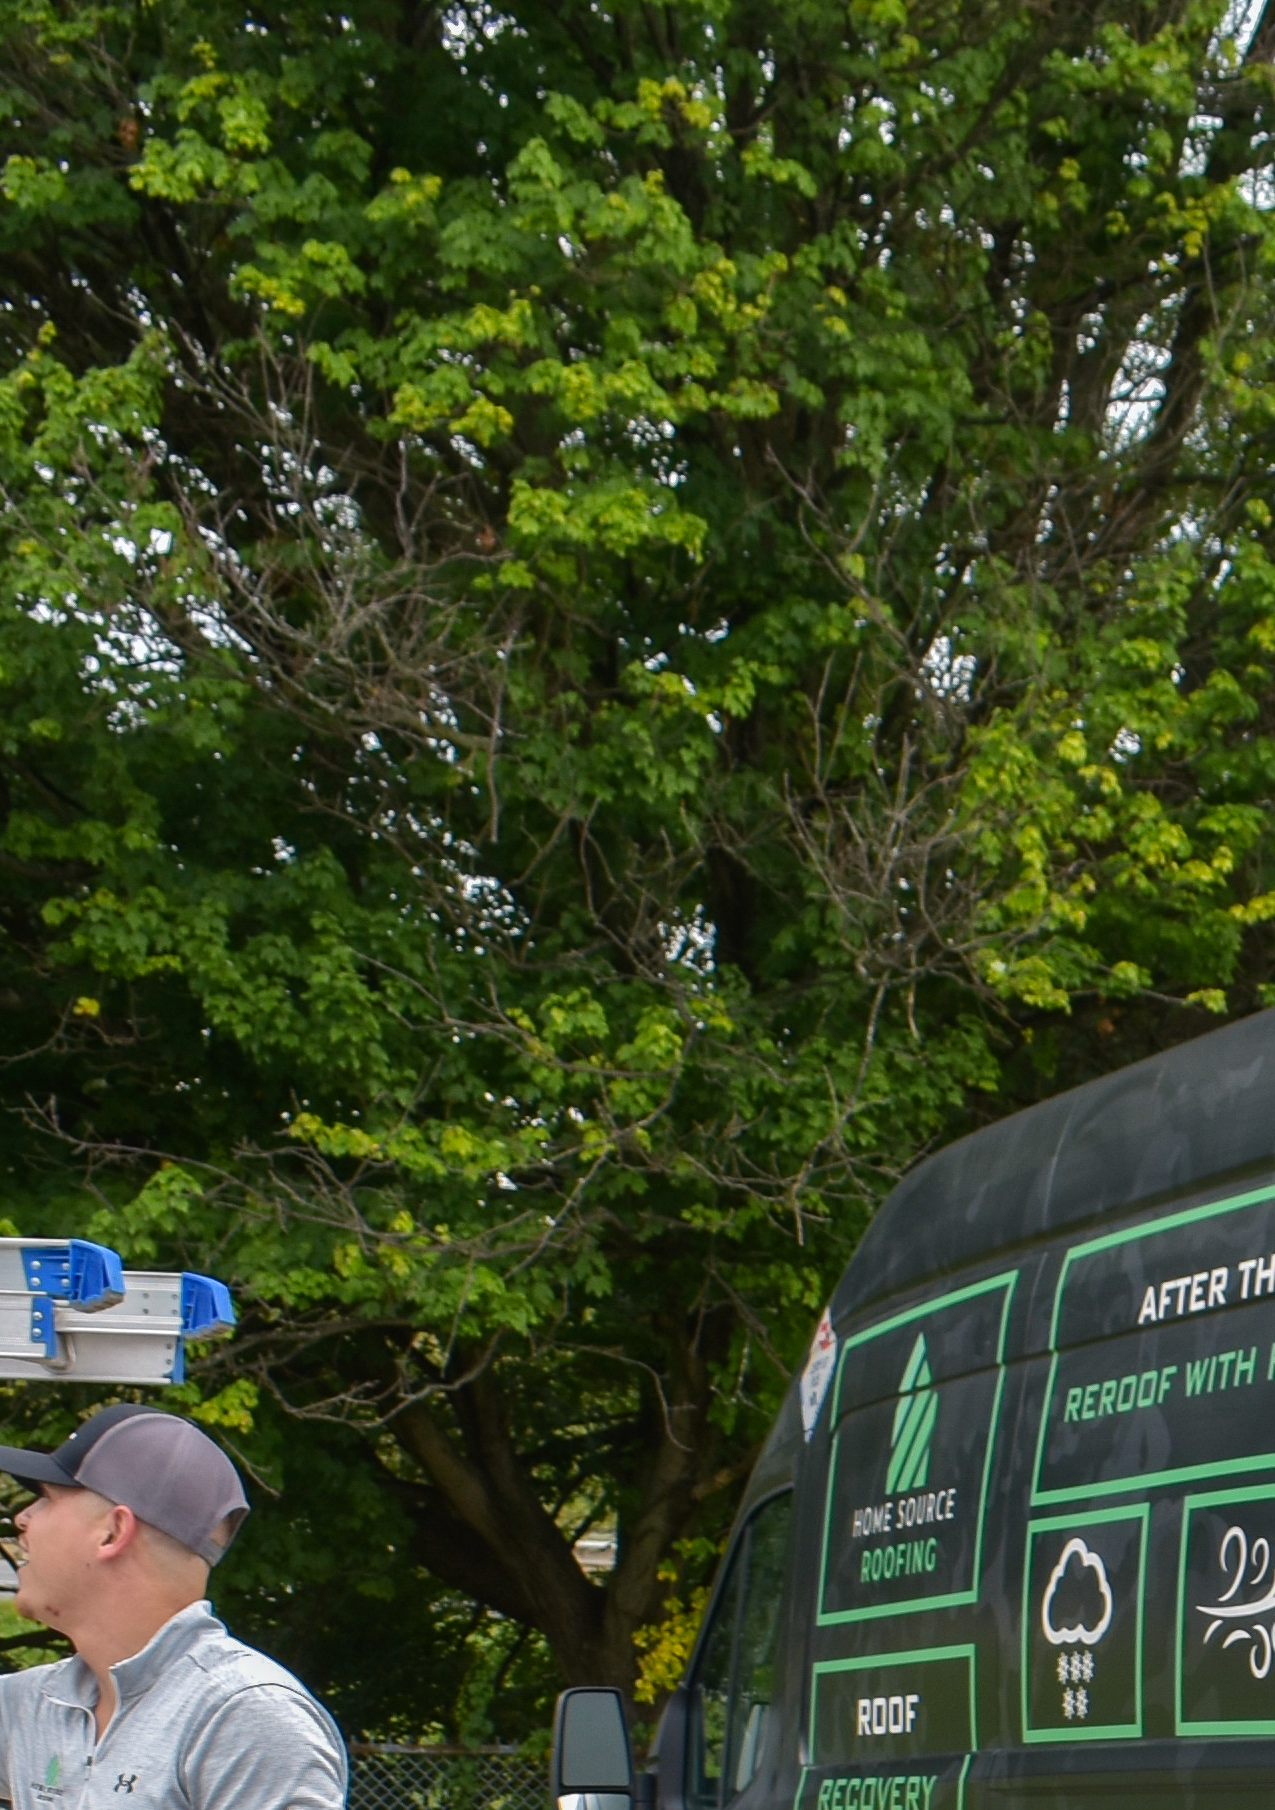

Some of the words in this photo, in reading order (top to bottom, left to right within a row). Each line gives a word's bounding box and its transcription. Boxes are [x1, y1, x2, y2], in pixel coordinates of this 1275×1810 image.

[1137, 1266, 1229, 1325] AFTER
[1063, 1365, 1178, 1423] REROOF
[1185, 1346, 1257, 1397] WITH
[852, 1501, 893, 1537] HOME
[895, 1488, 957, 1529] SOURCE
[860, 1537, 937, 1583] ROOFING
[857, 1695, 919, 1736] ROOF
